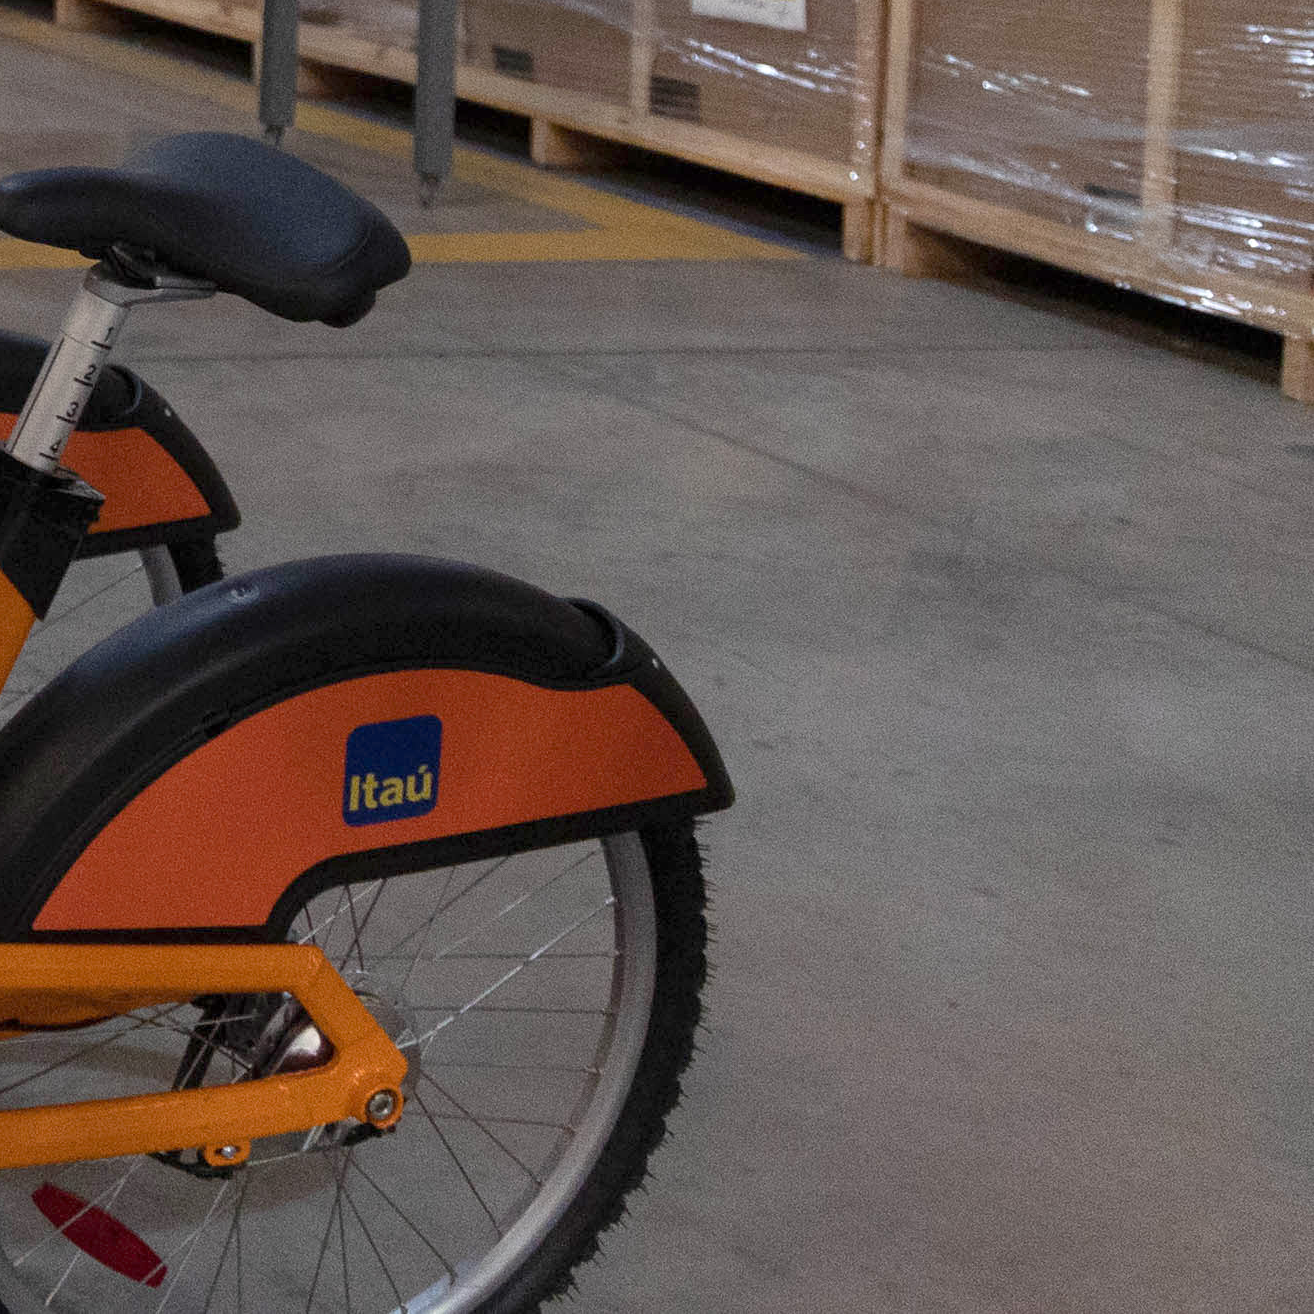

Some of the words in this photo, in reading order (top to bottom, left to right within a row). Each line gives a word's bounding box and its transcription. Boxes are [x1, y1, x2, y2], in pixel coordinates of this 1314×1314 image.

[84, 364, 96, 380] 2
[66, 401, 79, 418] 3
[349, 764, 433, 811] Itaú
